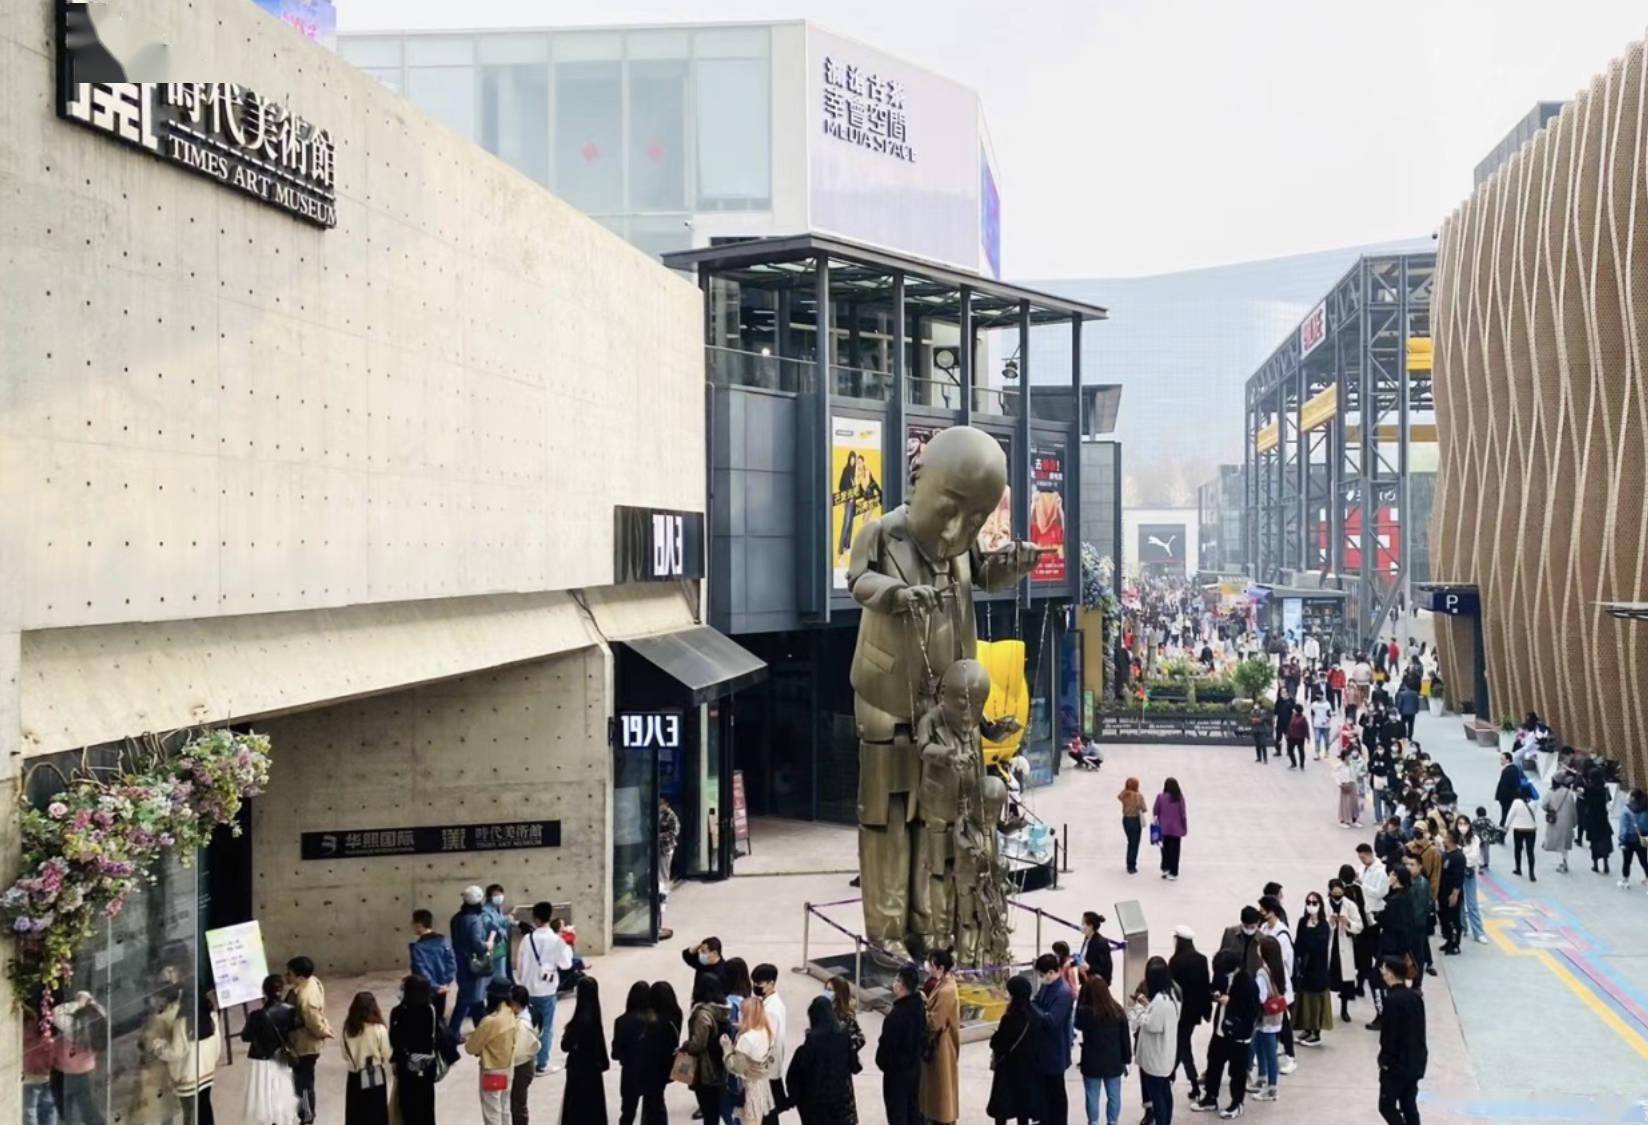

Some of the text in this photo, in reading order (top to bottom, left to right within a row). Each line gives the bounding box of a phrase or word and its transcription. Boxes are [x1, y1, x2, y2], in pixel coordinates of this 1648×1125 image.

[168, 133, 338, 226] TIMES ART MUSEUM
